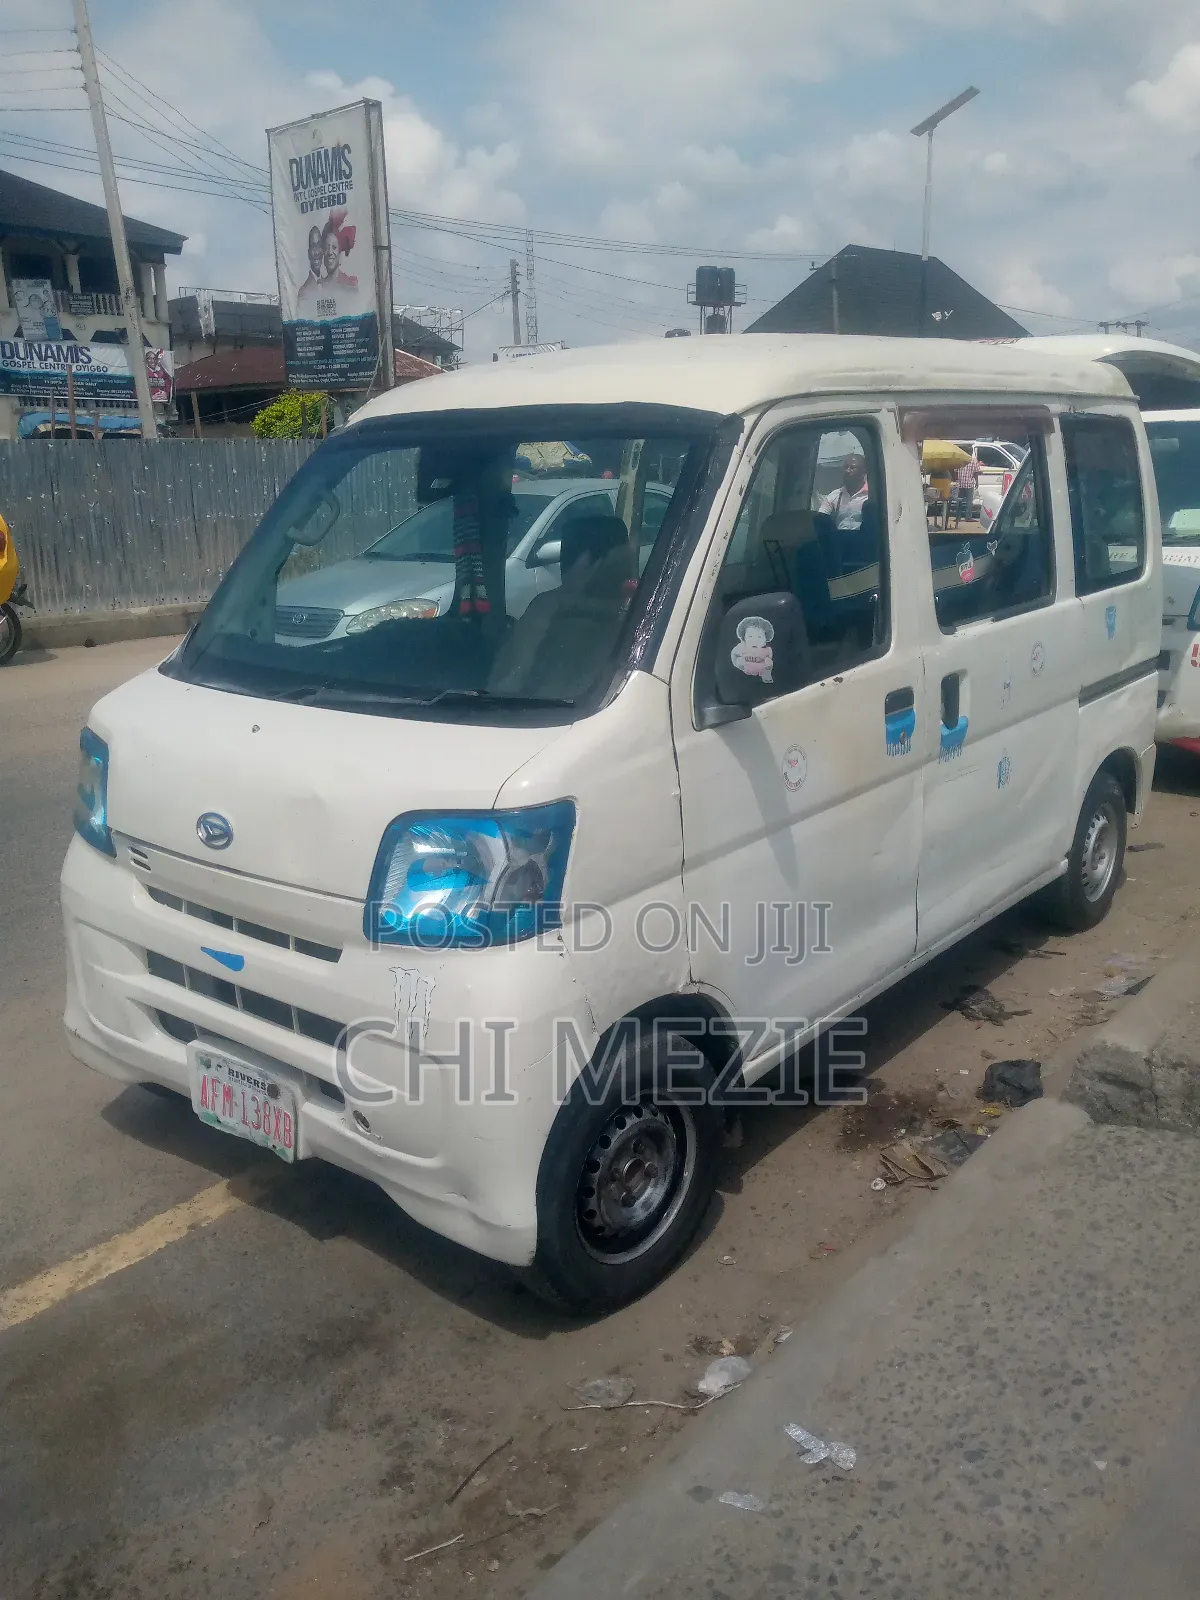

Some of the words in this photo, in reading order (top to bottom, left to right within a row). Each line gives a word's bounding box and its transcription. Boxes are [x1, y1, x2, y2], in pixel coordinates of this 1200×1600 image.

[289, 143, 353, 192] DUNAMIS
[327, 180, 354, 195] CENTRE
[300, 193, 347, 214] OYIGBO
[0, 341, 92, 364] DUNAMIS
[2, 359, 37, 369] GOSPEL
[75, 364, 109, 373] OYIGBO
[227, 1067, 267, 1091] RIVERS
[201, 1073, 292, 1149] AFM-138XB
